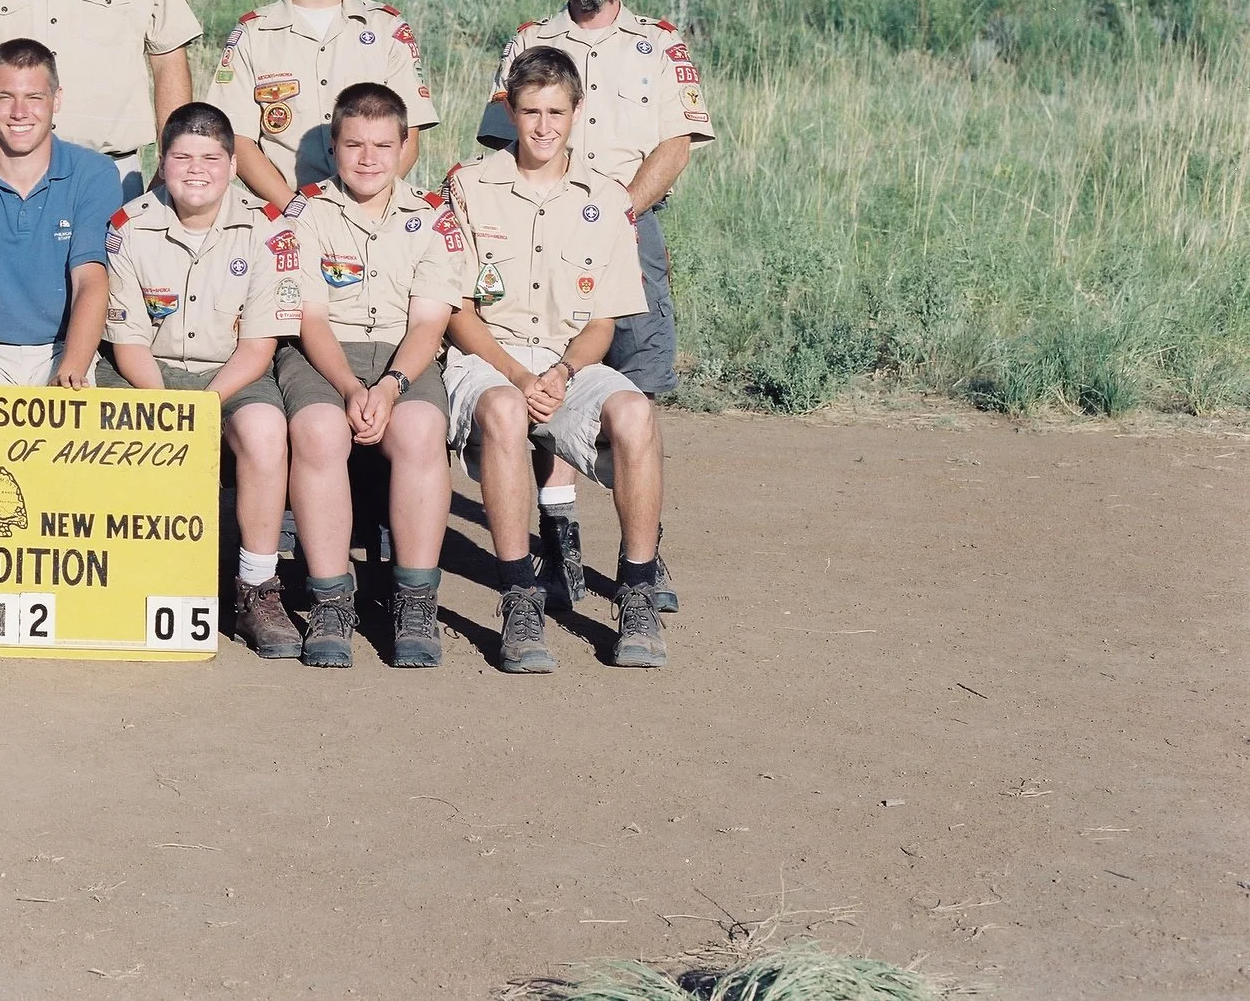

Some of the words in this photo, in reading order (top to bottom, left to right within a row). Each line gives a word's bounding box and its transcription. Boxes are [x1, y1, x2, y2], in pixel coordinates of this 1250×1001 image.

[100, 401, 195, 432] RANCH
[7, 439, 47, 462] OF
[52, 440, 190, 466] AMERICA
[41, 512, 95, 538] NEW
[106, 514, 204, 542] MEXICO
[154, 607, 211, 641] 05
